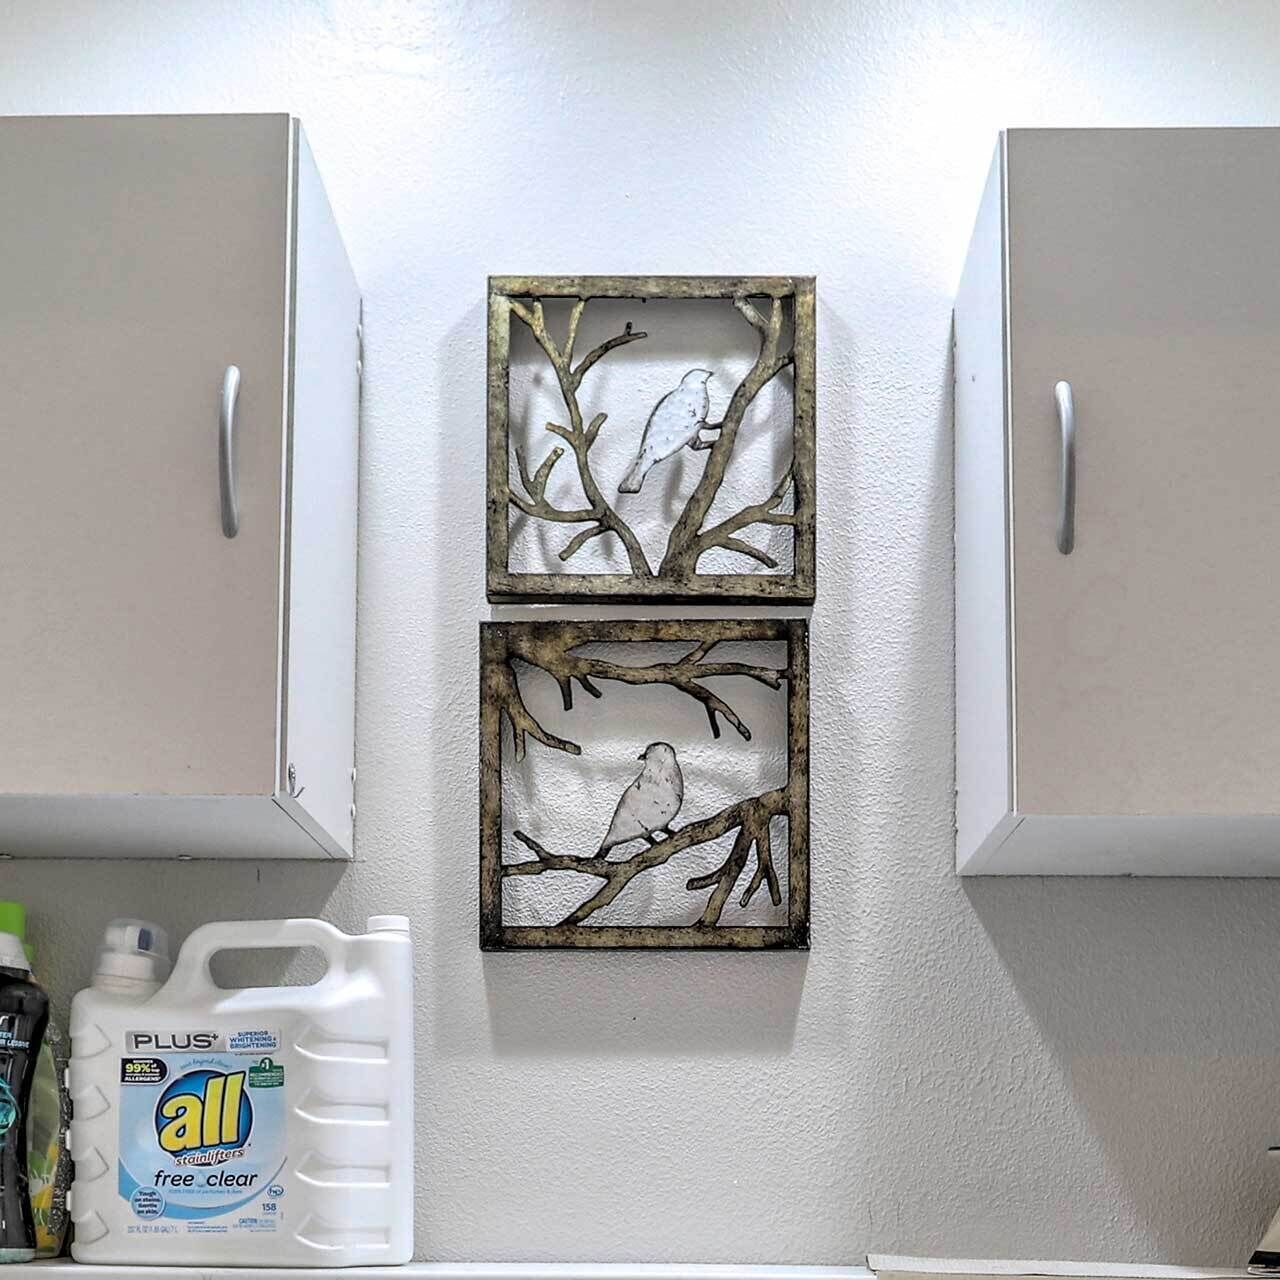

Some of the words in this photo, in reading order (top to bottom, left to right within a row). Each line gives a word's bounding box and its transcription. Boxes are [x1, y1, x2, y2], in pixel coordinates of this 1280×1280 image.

[230, 1035, 272, 1043] WHITENING
[125, 1063, 151, 1073] 99%
[158, 1070, 246, 1153] all
[176, 1149, 245, 1167] stainlifters
[154, 1169, 195, 1187] free
[206, 1170, 259, 1187] clear
[262, 1202, 277, 1212] 158
